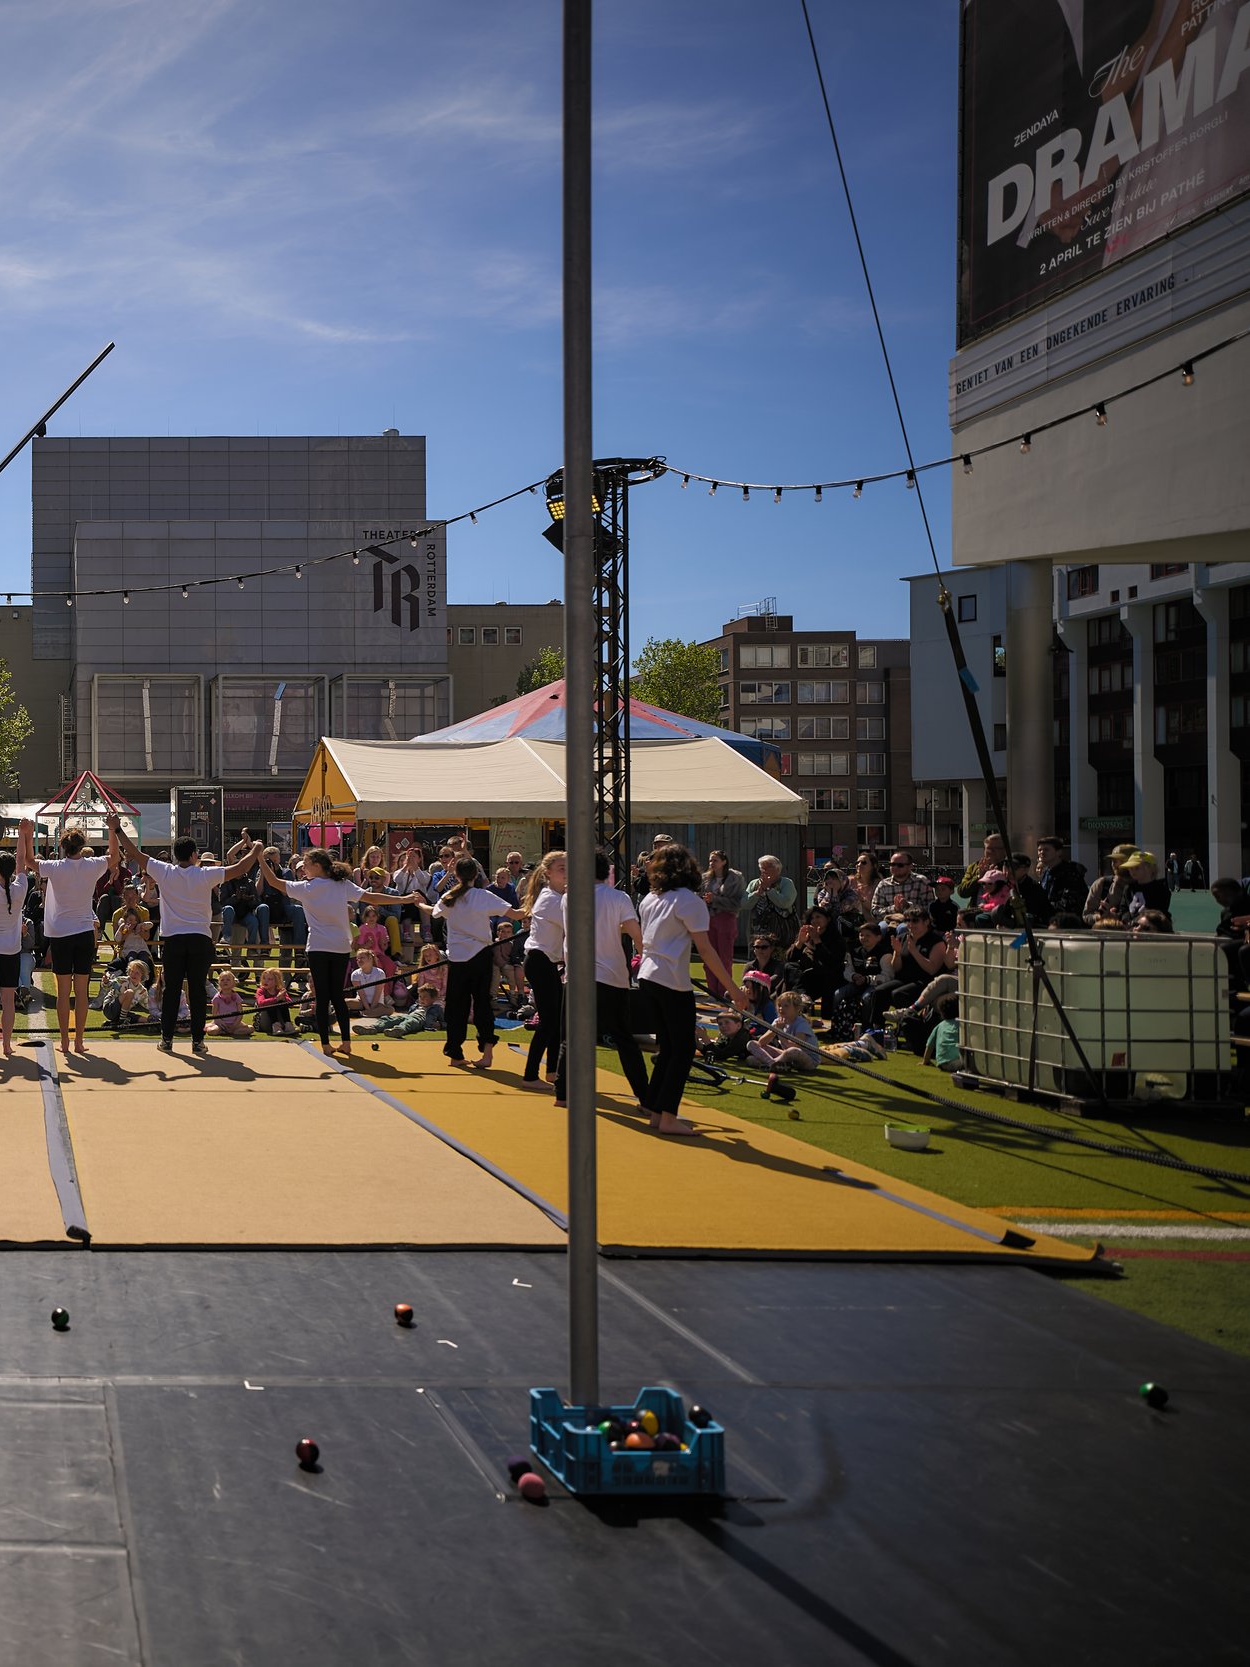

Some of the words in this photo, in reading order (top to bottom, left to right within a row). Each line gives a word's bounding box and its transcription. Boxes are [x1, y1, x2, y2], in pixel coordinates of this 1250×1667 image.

[1181, 0, 1230, 36] PATTIN
[1088, 44, 1145, 98] The
[1013, 109, 1059, 148] ZENDAYA
[1026, 215, 1063, 241] WRITTEN
[1064, 210, 1071, 220] &
[1071, 184, 1114, 215] DIRECTED
[1115, 175, 1128, 189] BY
[1128, 136, 1187, 181] KRISTOFFER
[1190, 111, 1228, 143] BORGLI
[1039, 263, 1047, 276] 2
[1049, 246, 1083, 271] APRIL
[1085, 233, 1101, 249] TE
[1103, 213, 1133, 239] ZIEN
[1136, 200, 1156, 220] BIJ
[1161, 167, 1206, 206] PATHÉ
[956, 367, 989, 395] GENIET
[994, 356, 1014, 375] VAN
[1020, 343, 1039, 363] EEN
[1046, 310, 1108, 350] ONGEKENDE
[1116, 274, 1175, 316] ERVARING
[426, 544, 436, 617] ROTTERDAM
